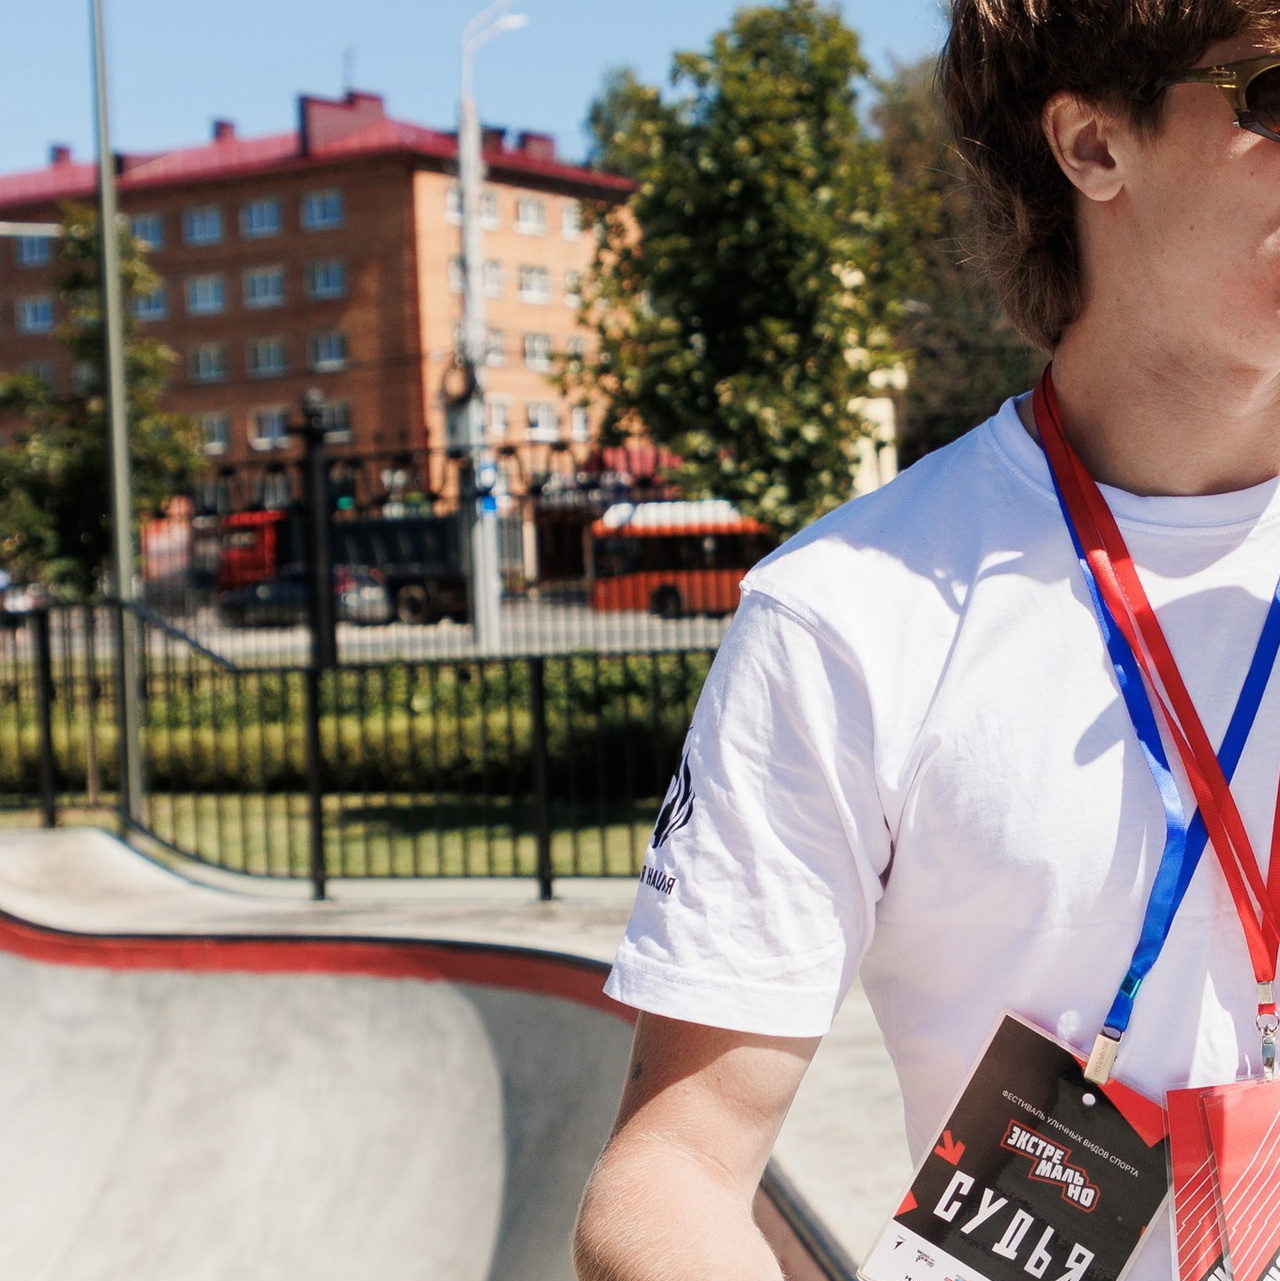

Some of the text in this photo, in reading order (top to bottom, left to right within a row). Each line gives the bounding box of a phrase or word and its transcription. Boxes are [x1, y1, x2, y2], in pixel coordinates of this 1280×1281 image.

[1002, 1090, 1139, 1178] ФЕСТИВАЛЬ УЛИЧНЫХ ВИДОВ СПОРТА
[1006, 1125, 1065, 1165] ЭКСТРЕ
[1034, 1159, 1085, 1186] МАЛЬ
[1067, 1184, 1095, 1207] НО
